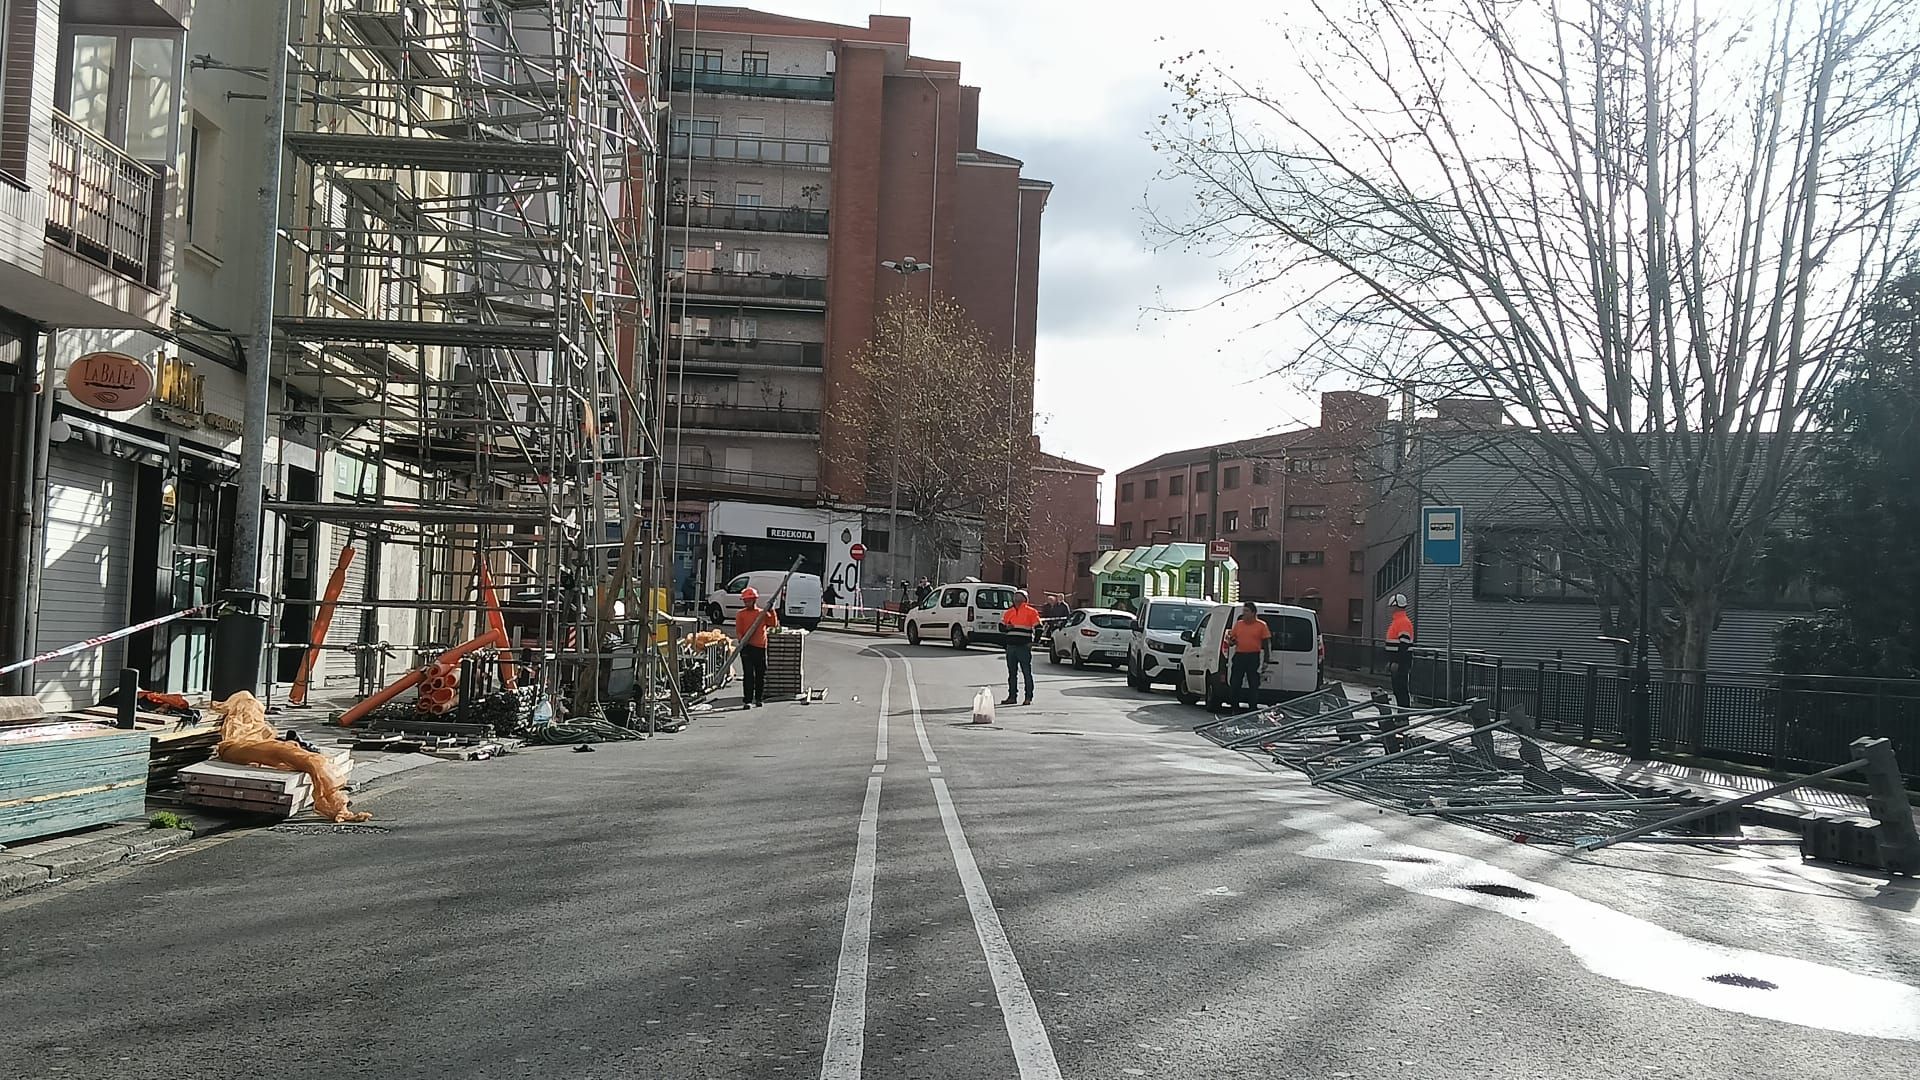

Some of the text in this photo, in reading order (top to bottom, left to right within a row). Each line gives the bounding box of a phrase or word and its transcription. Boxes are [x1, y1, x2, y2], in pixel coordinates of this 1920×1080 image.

[771, 529, 813, 540] REDEKORA
[1216, 544, 1229, 552] bus
[829, 562, 858, 592] 40
